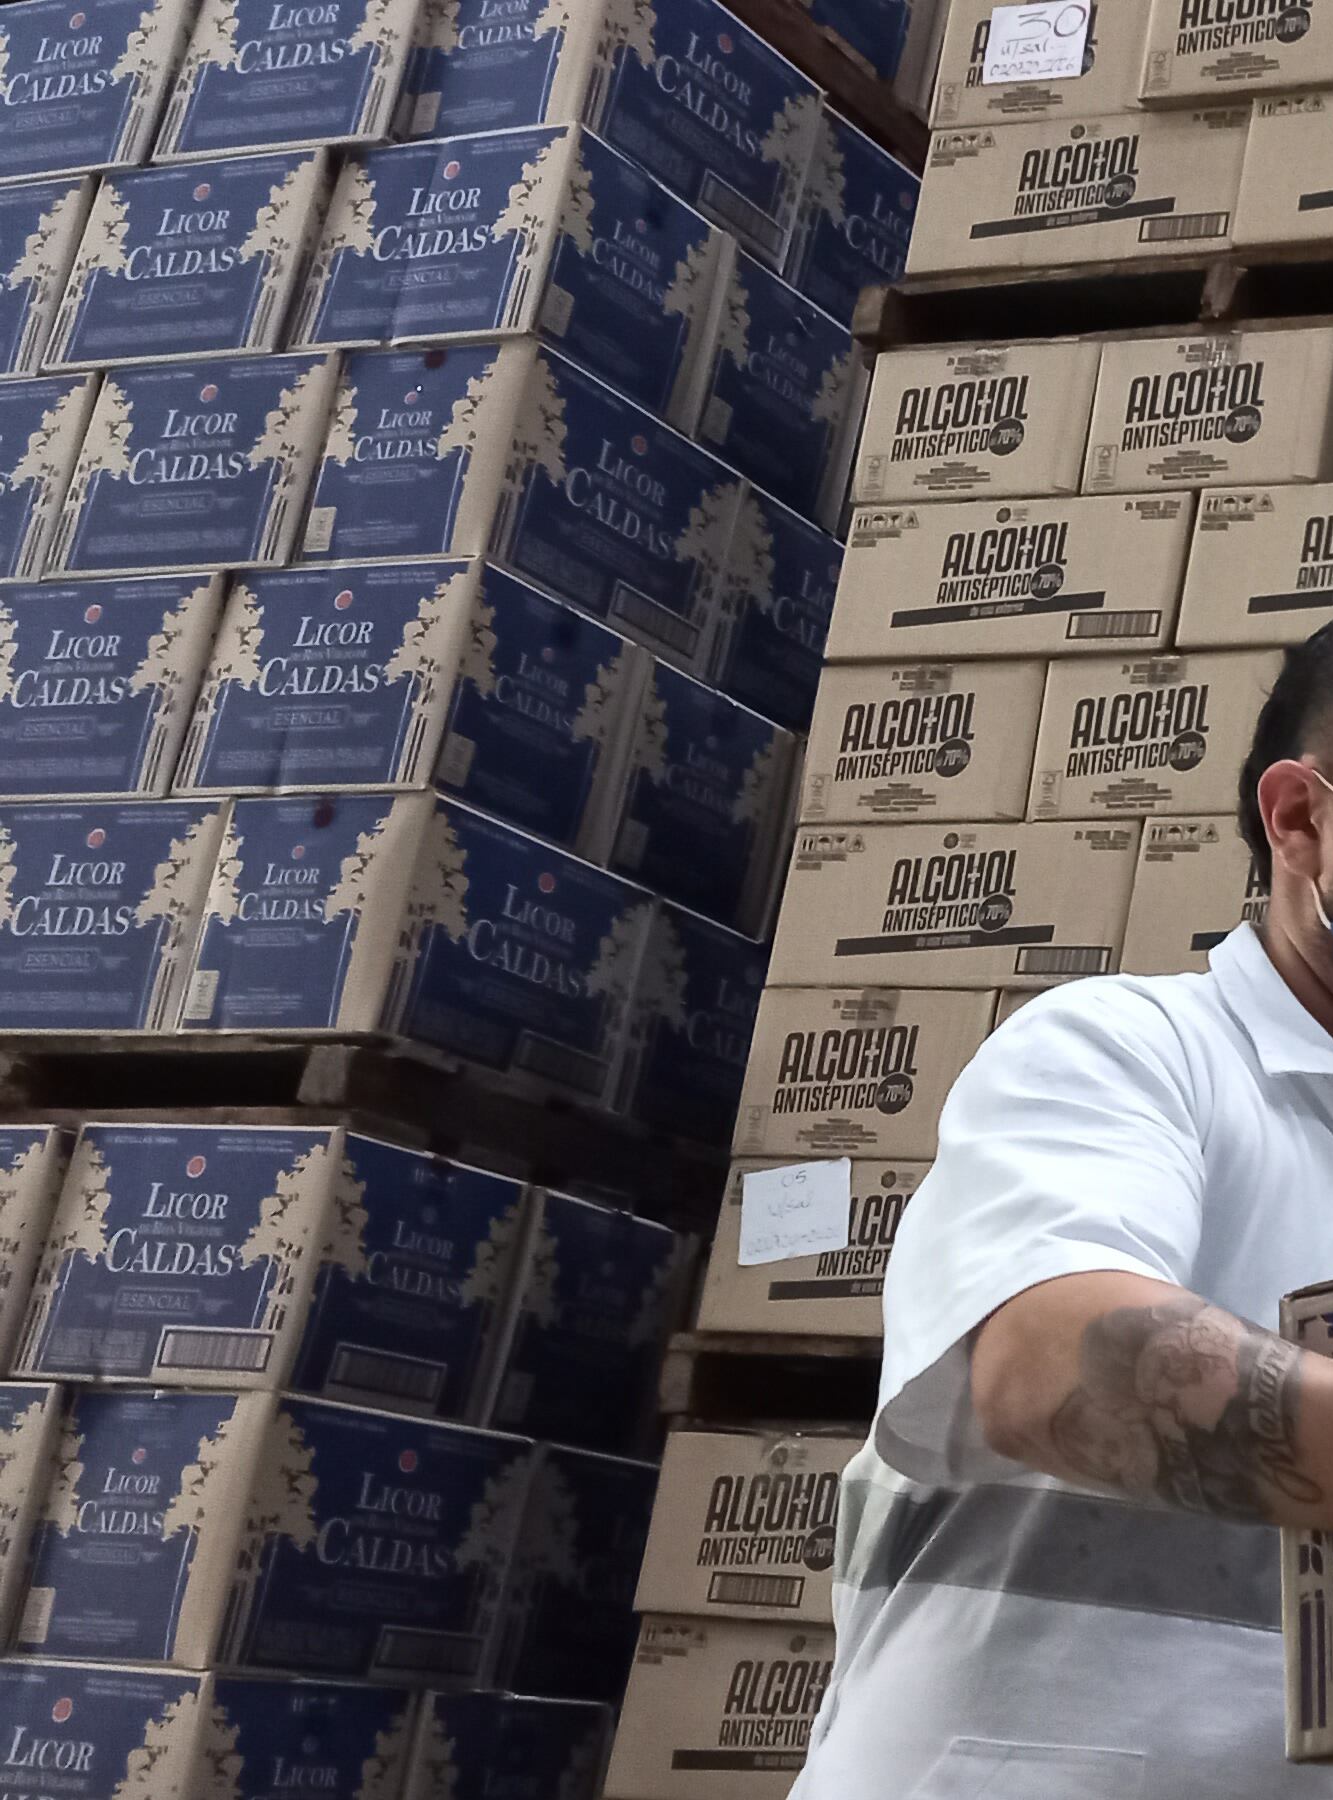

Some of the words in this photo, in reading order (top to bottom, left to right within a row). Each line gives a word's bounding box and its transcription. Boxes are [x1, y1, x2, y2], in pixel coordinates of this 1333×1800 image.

[1018, 134, 1141, 192] ALCOHOL
[1014, 181, 1105, 216] ANTISÉPTICO
[895, 375, 1029, 436] ALCOHOL
[1125, 361, 1265, 424] ALCOHOL
[890, 423, 990, 462] ANTISÉPTICO
[1121, 412, 1224, 452] ANTISÉPTICO
[941, 521, 1068, 578] ALCOHOL
[936, 569, 1031, 604] ANTISÉPTICO
[839, 693, 976, 753] ALCOHOL
[1070, 684, 1209, 751] ALCOHOL
[835, 743, 935, 782] ANTISÉPTICO
[1066, 739, 1169, 779] ANTISÉPTICO
[887, 850, 1017, 907] ALCOHOL
[882, 902, 979, 933] ANTISÉPTICO
[778, 1025, 920, 1084] ALCOHOL
[773, 1082, 877, 1115] ANTISÉPTICO
